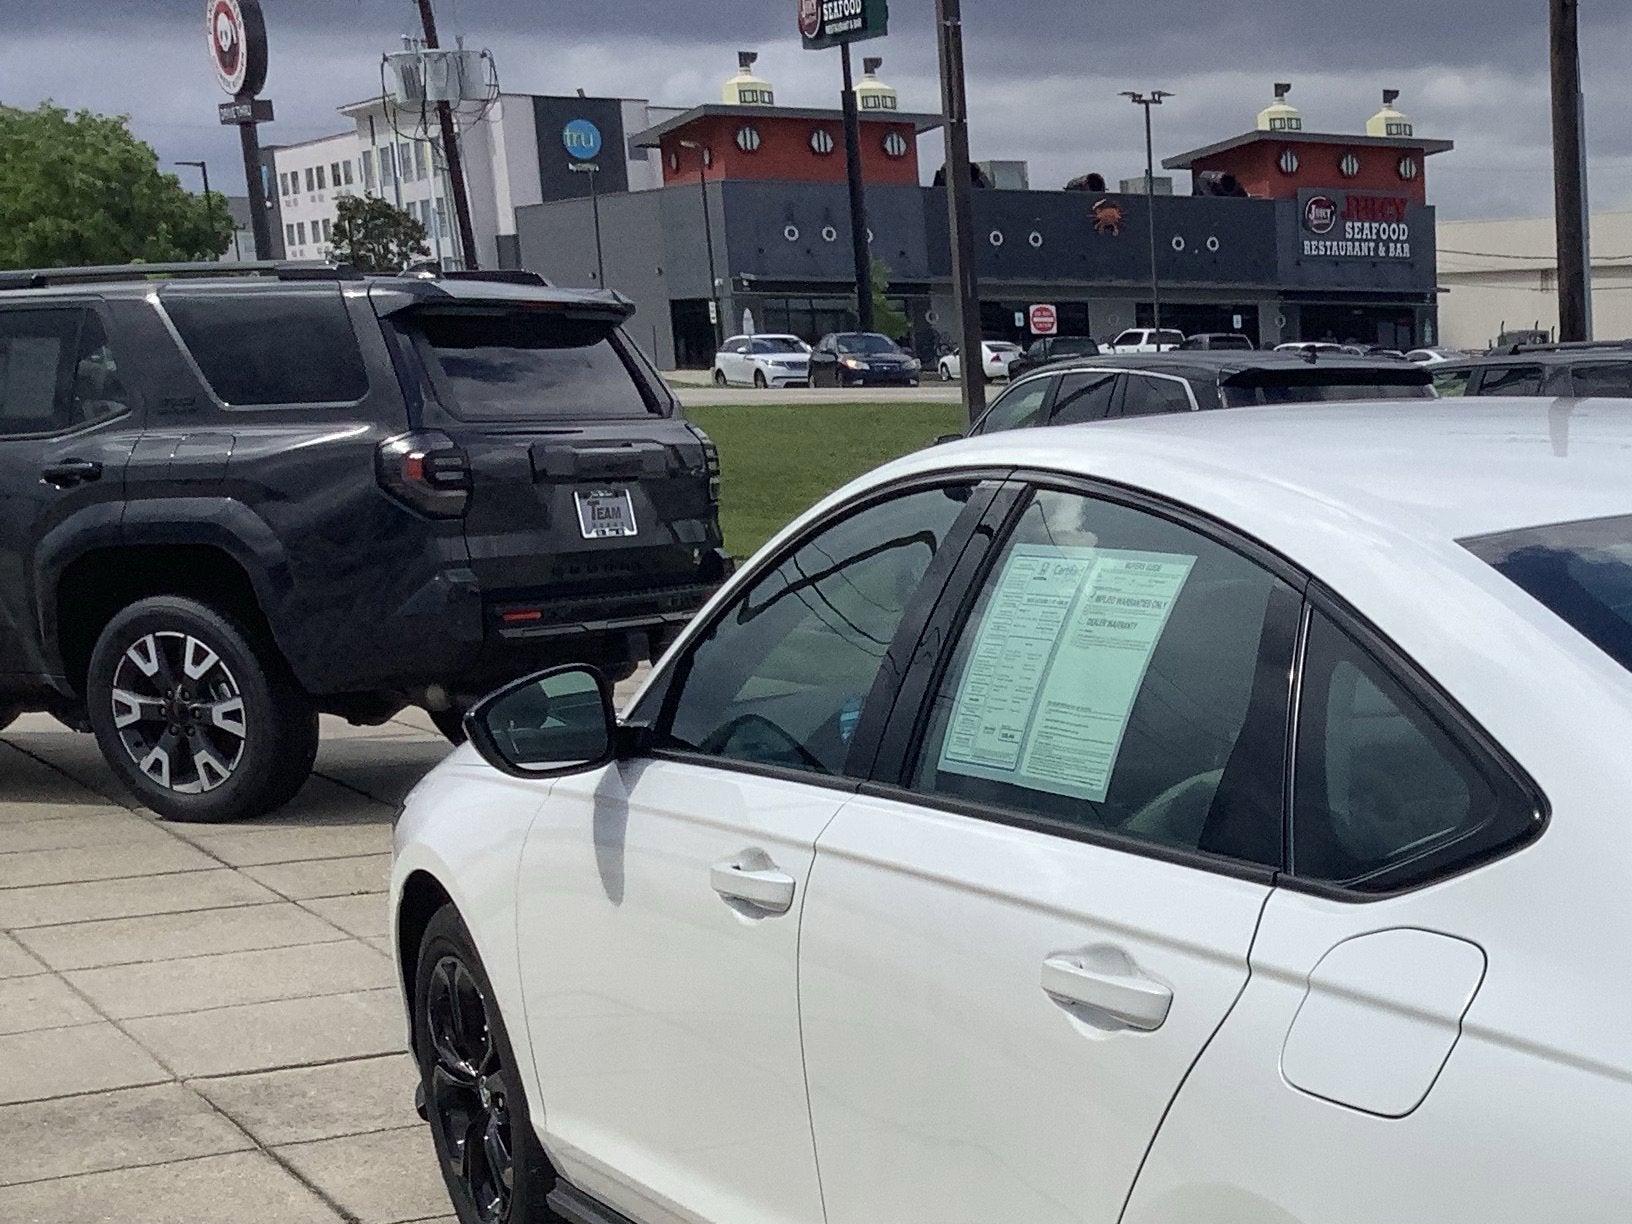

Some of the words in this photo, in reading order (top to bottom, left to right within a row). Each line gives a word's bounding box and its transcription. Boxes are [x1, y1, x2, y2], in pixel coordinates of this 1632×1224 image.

[823, 0, 862, 21] SEAFOOD
[563, 128, 594, 148] tru
[1342, 196, 1408, 222] JUICY
[1345, 221, 1408, 240] SEAFOOD
[1303, 240, 1376, 256] RESTAURANT
[1377, 242, 1386, 257] &
[1388, 243, 1410, 258] BAR
[587, 500, 622, 521] TEAM
